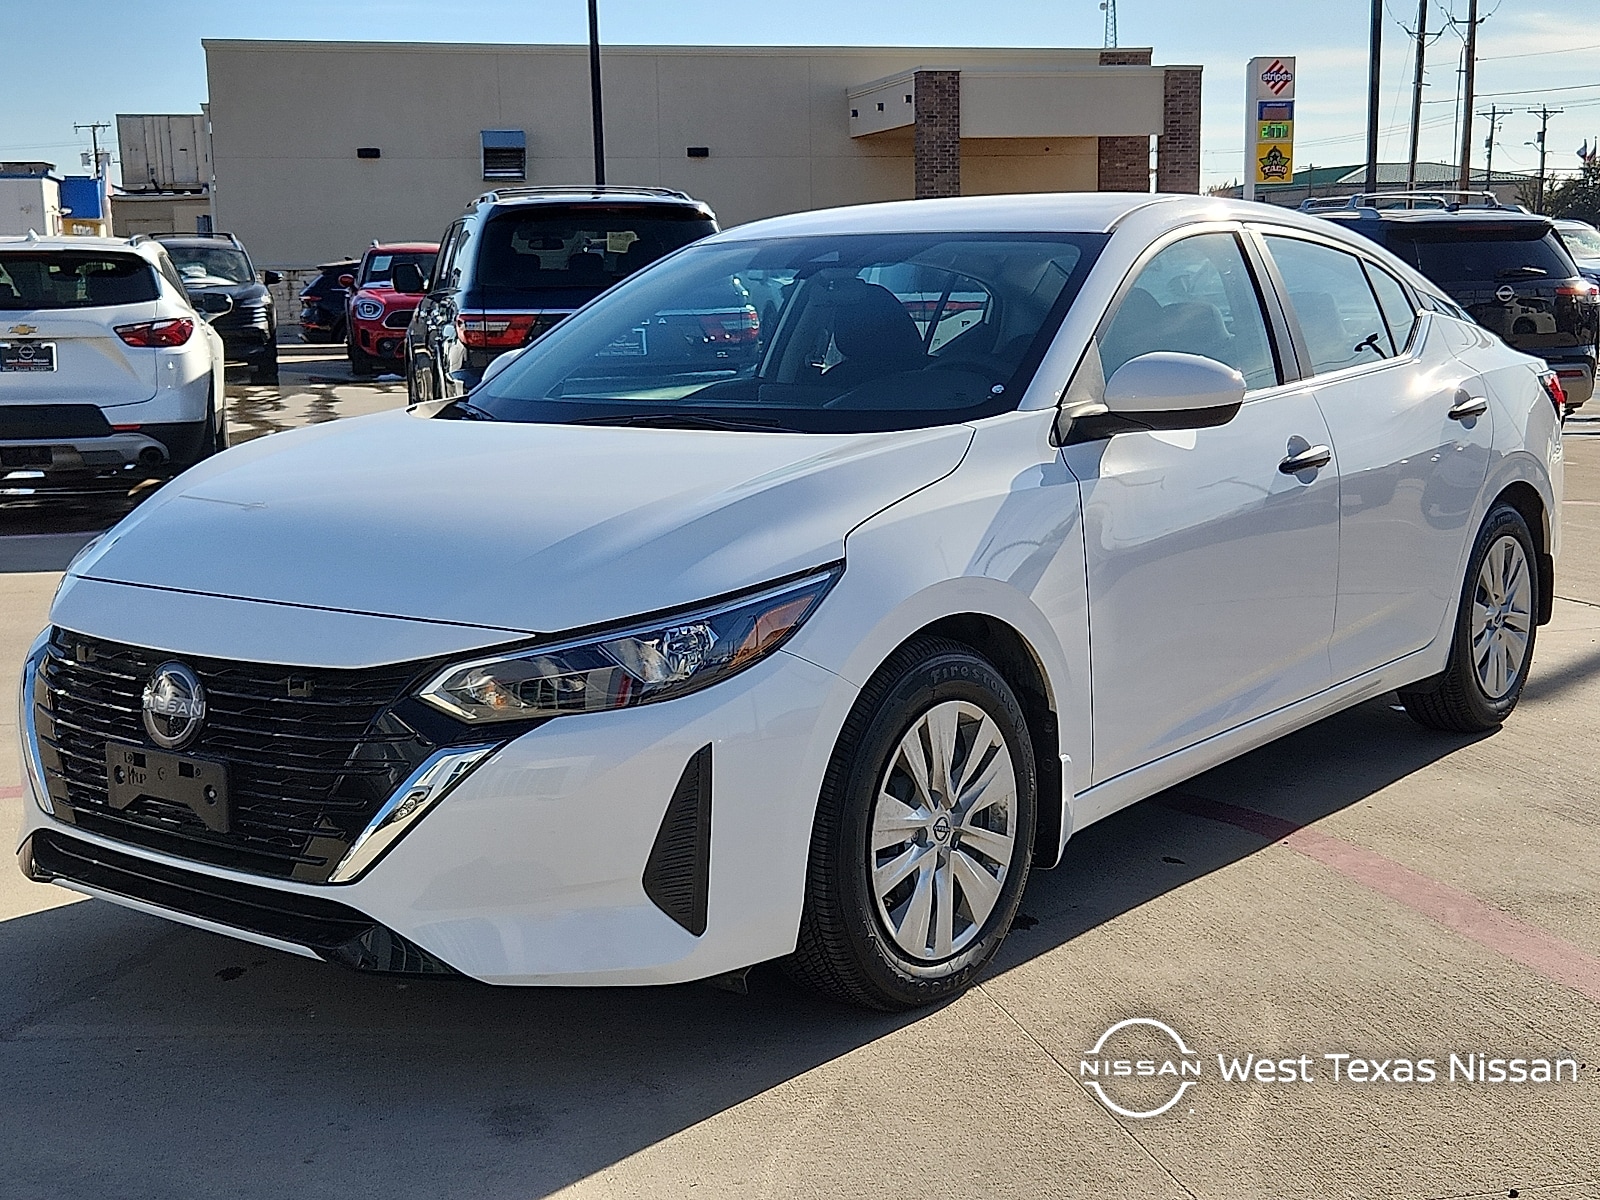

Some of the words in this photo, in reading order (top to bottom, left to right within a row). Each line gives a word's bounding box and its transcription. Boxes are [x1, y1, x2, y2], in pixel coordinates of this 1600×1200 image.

[1262, 72, 1293, 83] stripes
[1262, 165, 1288, 174] TACO
[930, 665, 1016, 714] Firestone
